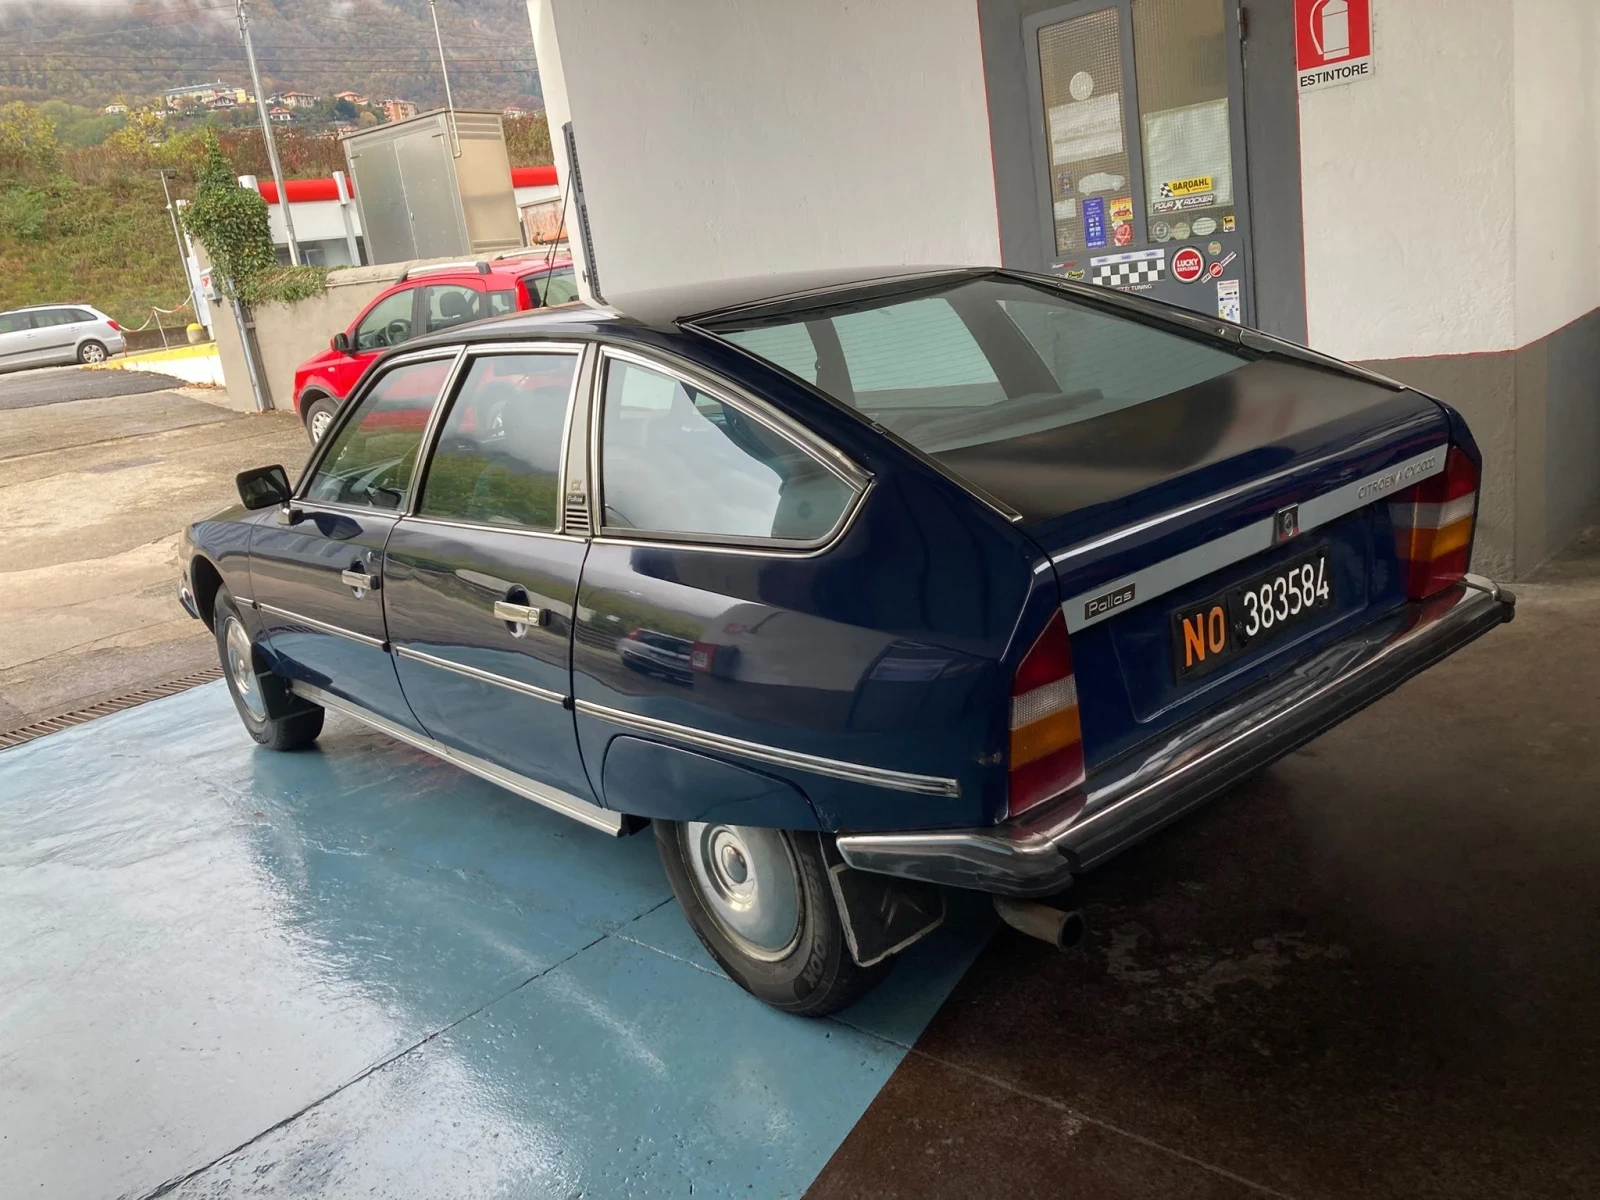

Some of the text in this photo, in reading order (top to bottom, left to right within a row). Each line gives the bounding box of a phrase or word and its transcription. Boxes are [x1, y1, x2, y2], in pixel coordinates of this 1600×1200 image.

[1300, 62, 1369, 88] ESTINTORE
[1172, 178, 1209, 192] BARDAHL
[1154, 201, 1173, 210] FOUR
[1183, 194, 1214, 205] ROCKER
[1177, 258, 1199, 267] LUCKY
[571, 479, 582, 492] CX
[1357, 472, 1398, 500] CITROËN
[1088, 590, 1132, 616] Pallas
[1182, 556, 1330, 667] NO 383584
